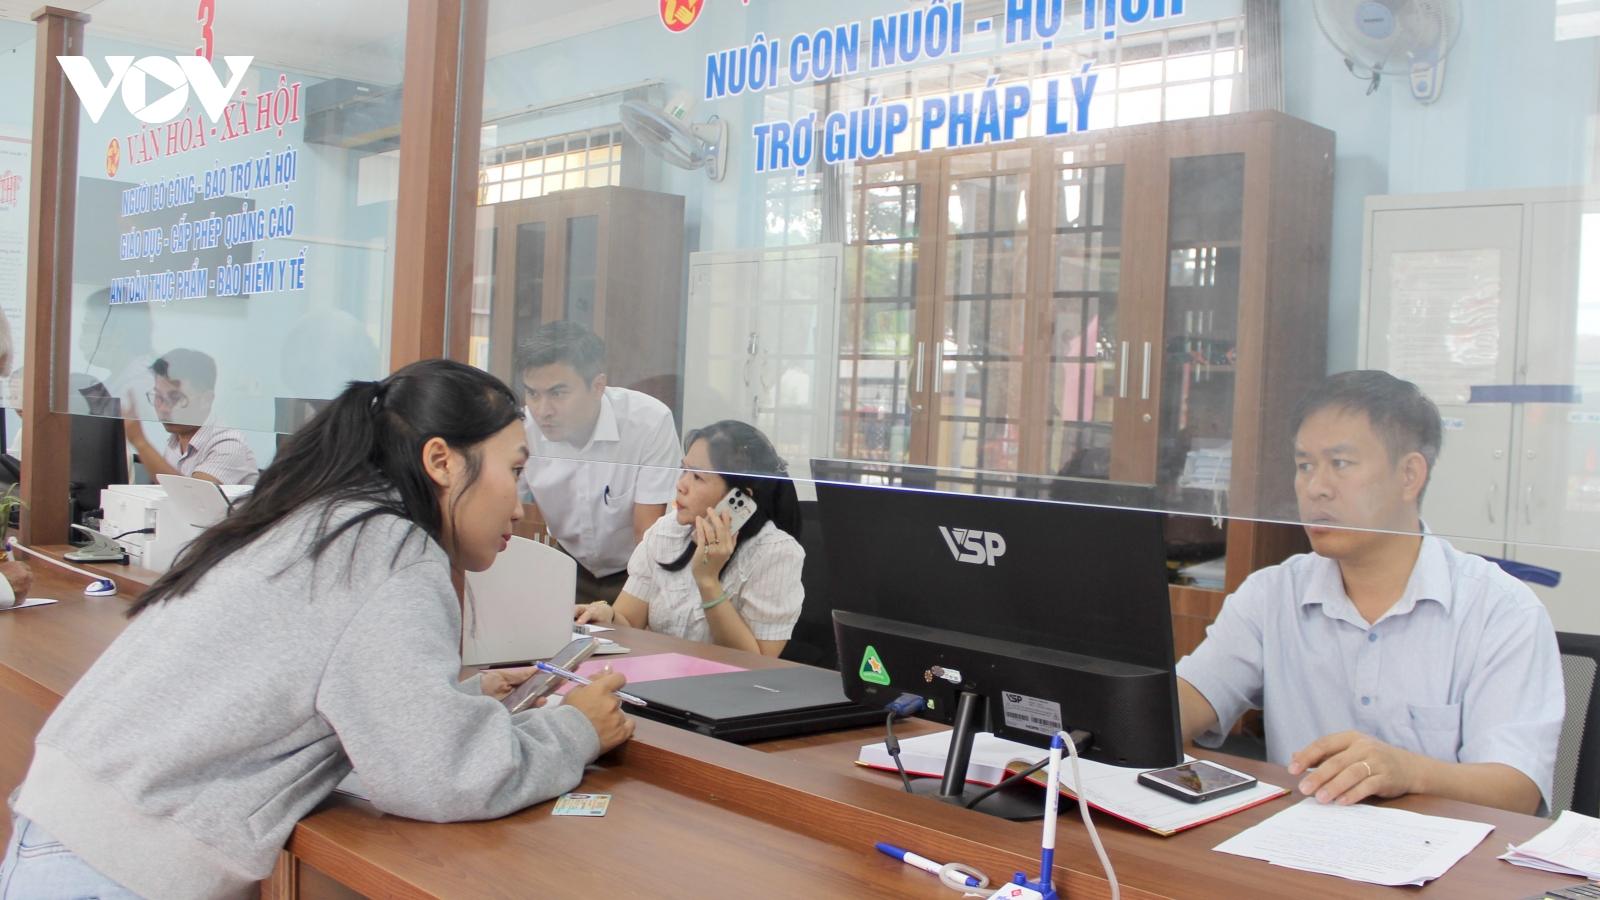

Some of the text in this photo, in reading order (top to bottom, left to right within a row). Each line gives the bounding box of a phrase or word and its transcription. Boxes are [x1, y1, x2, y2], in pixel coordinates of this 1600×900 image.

[195, 0, 216, 63] 3
[706, 33, 780, 100] NUÔI
[789, 21, 860, 85] CON
[870, 0, 963, 70] NUÔI
[127, 123, 162, 166] VĂN
[166, 106, 206, 156] HÓA
[220, 90, 250, 141] XÃ
[255, 75, 301, 138] HỘI
[753, 61, 1099, 178] TRỢ GIÚP PHÁP LÝ
[152, 176, 165, 212] CÓ
[167, 173, 195, 208] CÔNG
[204, 160, 227, 200] BẢO
[230, 157, 253, 198] TRỢ
[254, 150, 271, 190] XÃ
[275, 145, 298, 190] HỘI
[120, 227, 141, 260] GIÁO
[142, 227, 163, 262] DỤC
[170, 213, 192, 253] CẤP
[193, 212, 223, 250] PHÉP
[224, 202, 265, 249] QUẢNG
[268, 199, 295, 239] CÁO
[110, 277, 123, 305] AN
[124, 270, 149, 304] TOÀN
[149, 270, 175, 307] THỰC
[176, 258, 209, 300] PHẨM
[217, 255, 241, 297] BẢO
[242, 249, 275, 294] HIỂM
[278, 259, 287, 292] Y
[289, 246, 308, 290] TẾ
[938, 525, 1006, 566] VSP
[1005, 692, 1023, 704] VSP
